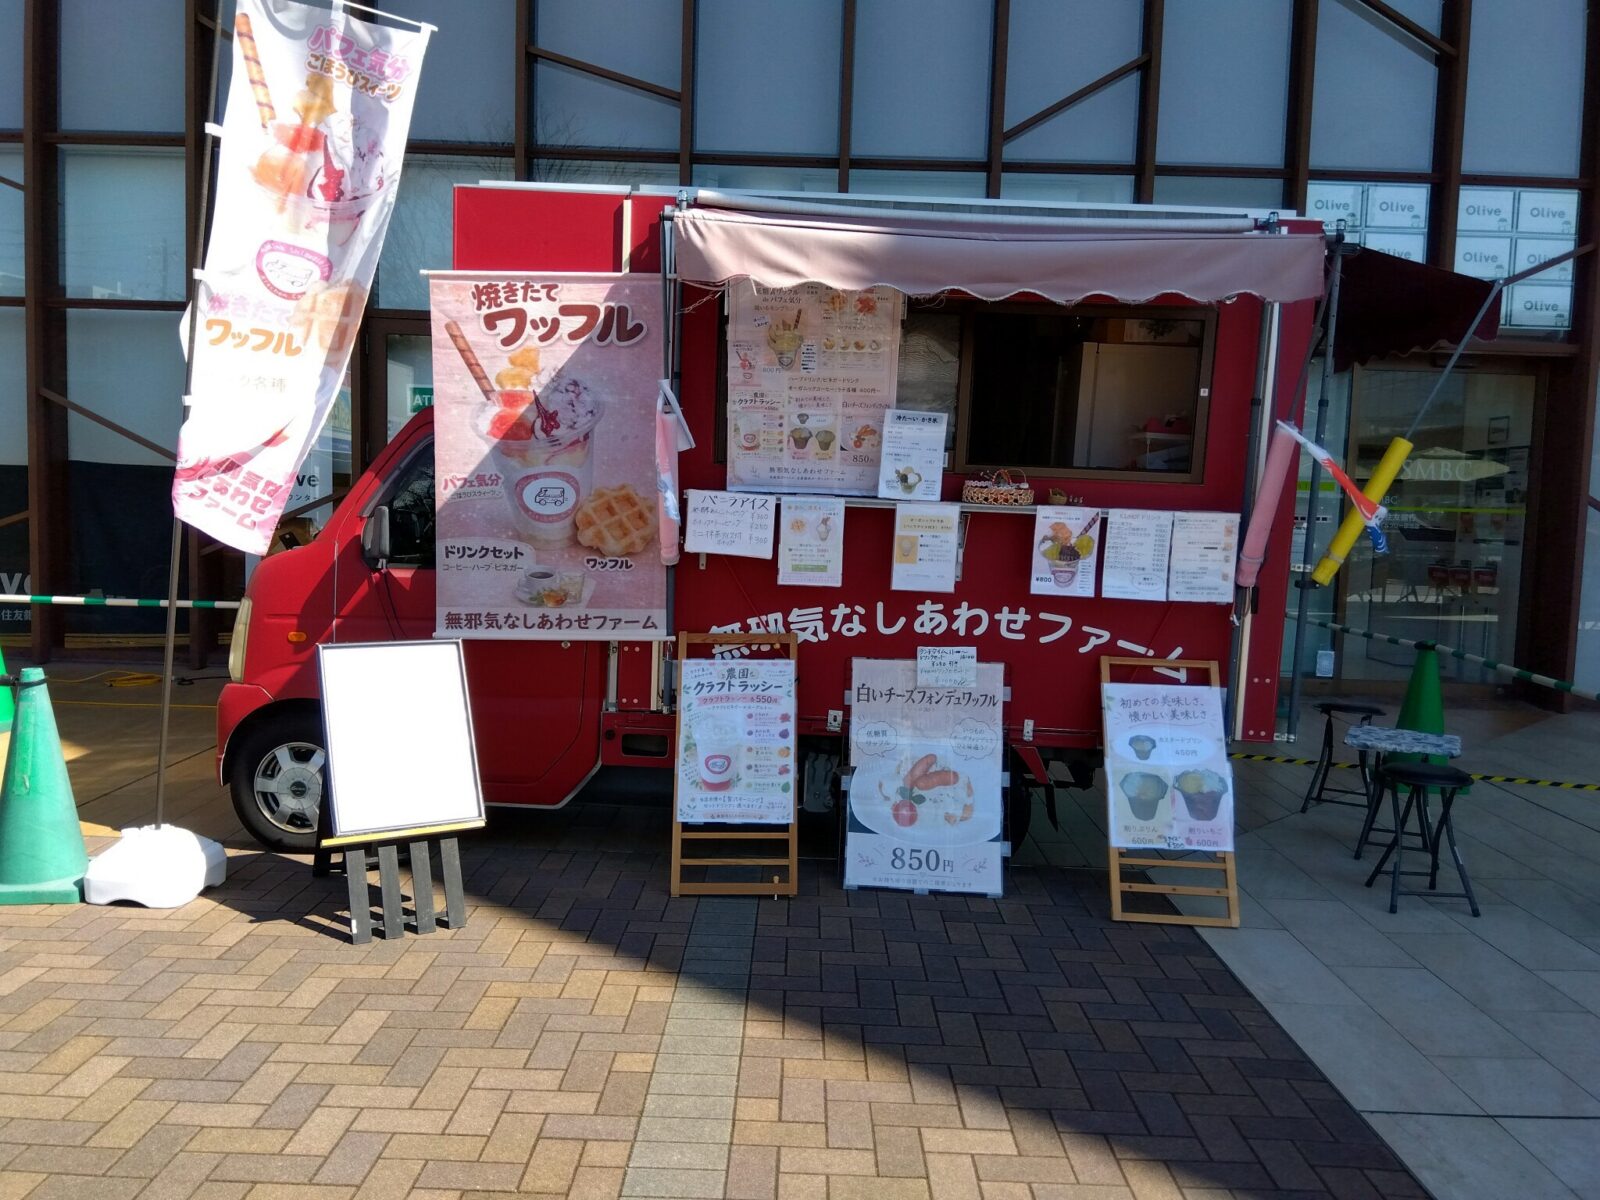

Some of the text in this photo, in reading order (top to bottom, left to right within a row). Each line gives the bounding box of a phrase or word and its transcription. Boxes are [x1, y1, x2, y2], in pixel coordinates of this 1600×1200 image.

[307, 25, 410, 82] パフェ気分
[1314, 198, 1351, 212] Olive
[1379, 200, 1415, 213] Olive
[1465, 204, 1502, 217] Olive
[1529, 206, 1566, 219] Olive
[1462, 251, 1499, 264] Olive
[471, 281, 560, 311] 焼きたて
[1523, 300, 1559, 312] Olive
[483, 302, 644, 348] ワッフル
[205, 318, 303, 357] ワッフル
[413, 394, 434, 407] AT
[1400, 459, 1472, 482] SMBC
[442, 473, 502, 491] パフェ気分
[701, 495, 770, 511] バニラアイス
[444, 545, 524, 561] ドリンクセット
[585, 557, 633, 571] ワッフル
[445, 610, 659, 631] 無邪気なしあわせファーム
[693, 680, 784, 696] クラフトラッシー
[856, 684, 1000, 708] 白いチーズフォンデュワッフル
[1128, 710, 1208, 723] 懐かしい美味しさ
[1131, 837, 1155, 845] 600円
[1196, 839, 1219, 848] 600円
[890, 847, 954, 872] 850円
